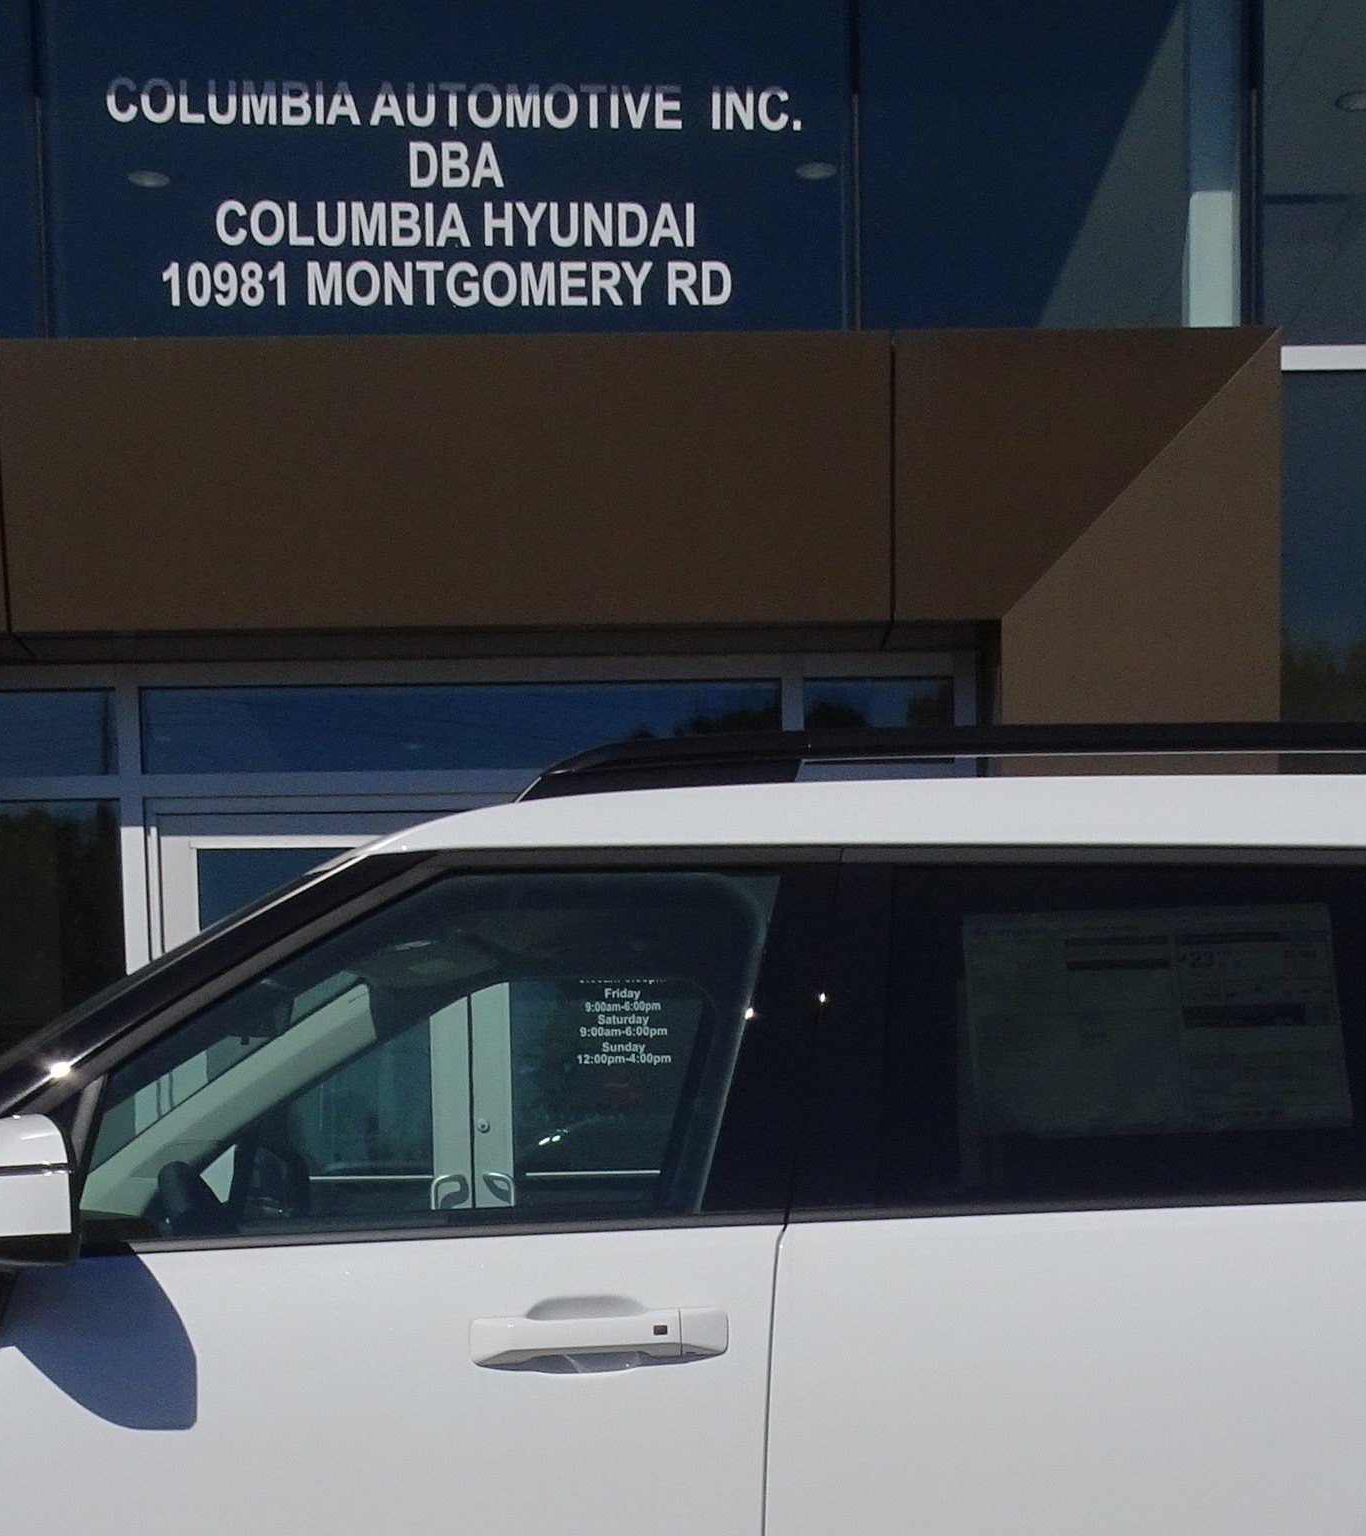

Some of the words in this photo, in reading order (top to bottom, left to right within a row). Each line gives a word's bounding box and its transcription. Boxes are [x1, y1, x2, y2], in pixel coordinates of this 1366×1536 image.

[106, 77, 362, 126] COLUMBIA
[370, 81, 683, 130] AUTOMOTIVE
[711, 85, 803, 132] INC.
[408, 141, 504, 188] DBA
[215, 200, 471, 248] COLUMBIA
[484, 202, 696, 249] HYUNDAI
[162, 261, 287, 307] 10981
[306, 261, 659, 308] MONTGOMERY
[667, 261, 733, 307] RD
[604, 988, 641, 1000] Friday
[585, 1001, 661, 1013] 9:00am-6:00pm
[597, 1014, 649, 1026] Saturday
[579, 1026, 668, 1038] 9:00am-6:00pm
[602, 1042, 646, 1054] Sunday
[577, 1054, 672, 1066] 12:00pm-4:00pm
